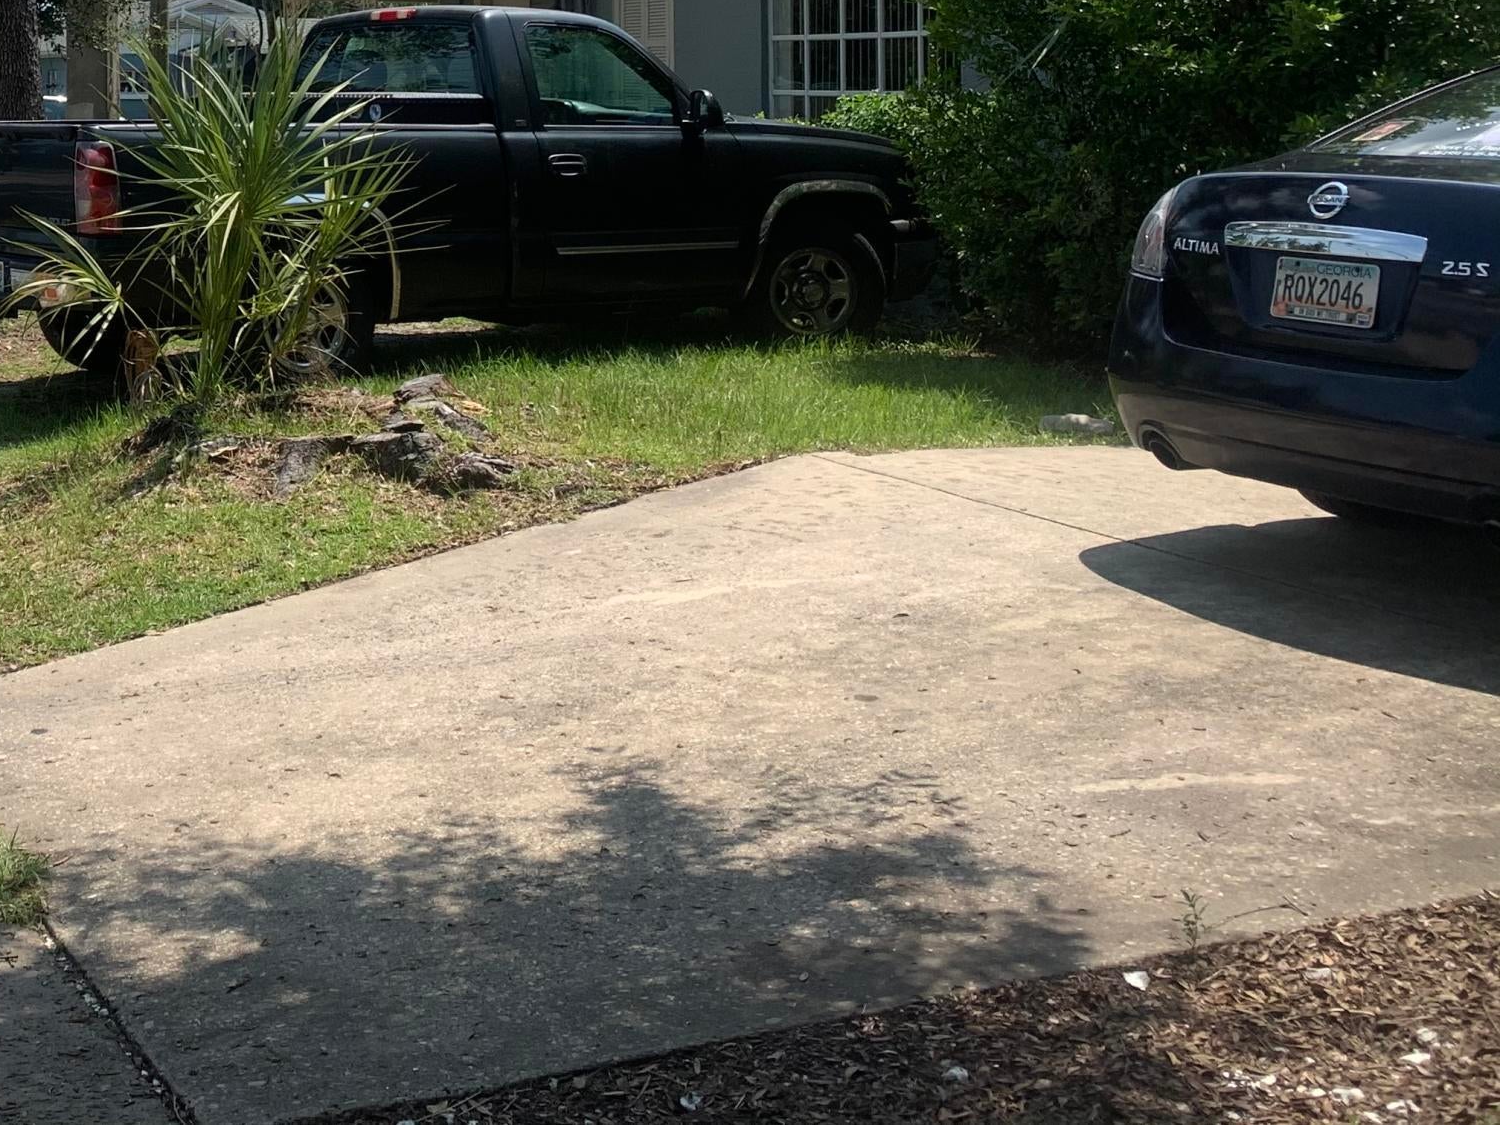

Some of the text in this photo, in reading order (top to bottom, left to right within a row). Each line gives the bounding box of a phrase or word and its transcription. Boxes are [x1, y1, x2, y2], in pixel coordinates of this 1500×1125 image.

[1173, 236, 1220, 255] ALTIMA
[1316, 263, 1372, 279] GEORGIA
[1441, 260, 1491, 277] 2.5 S
